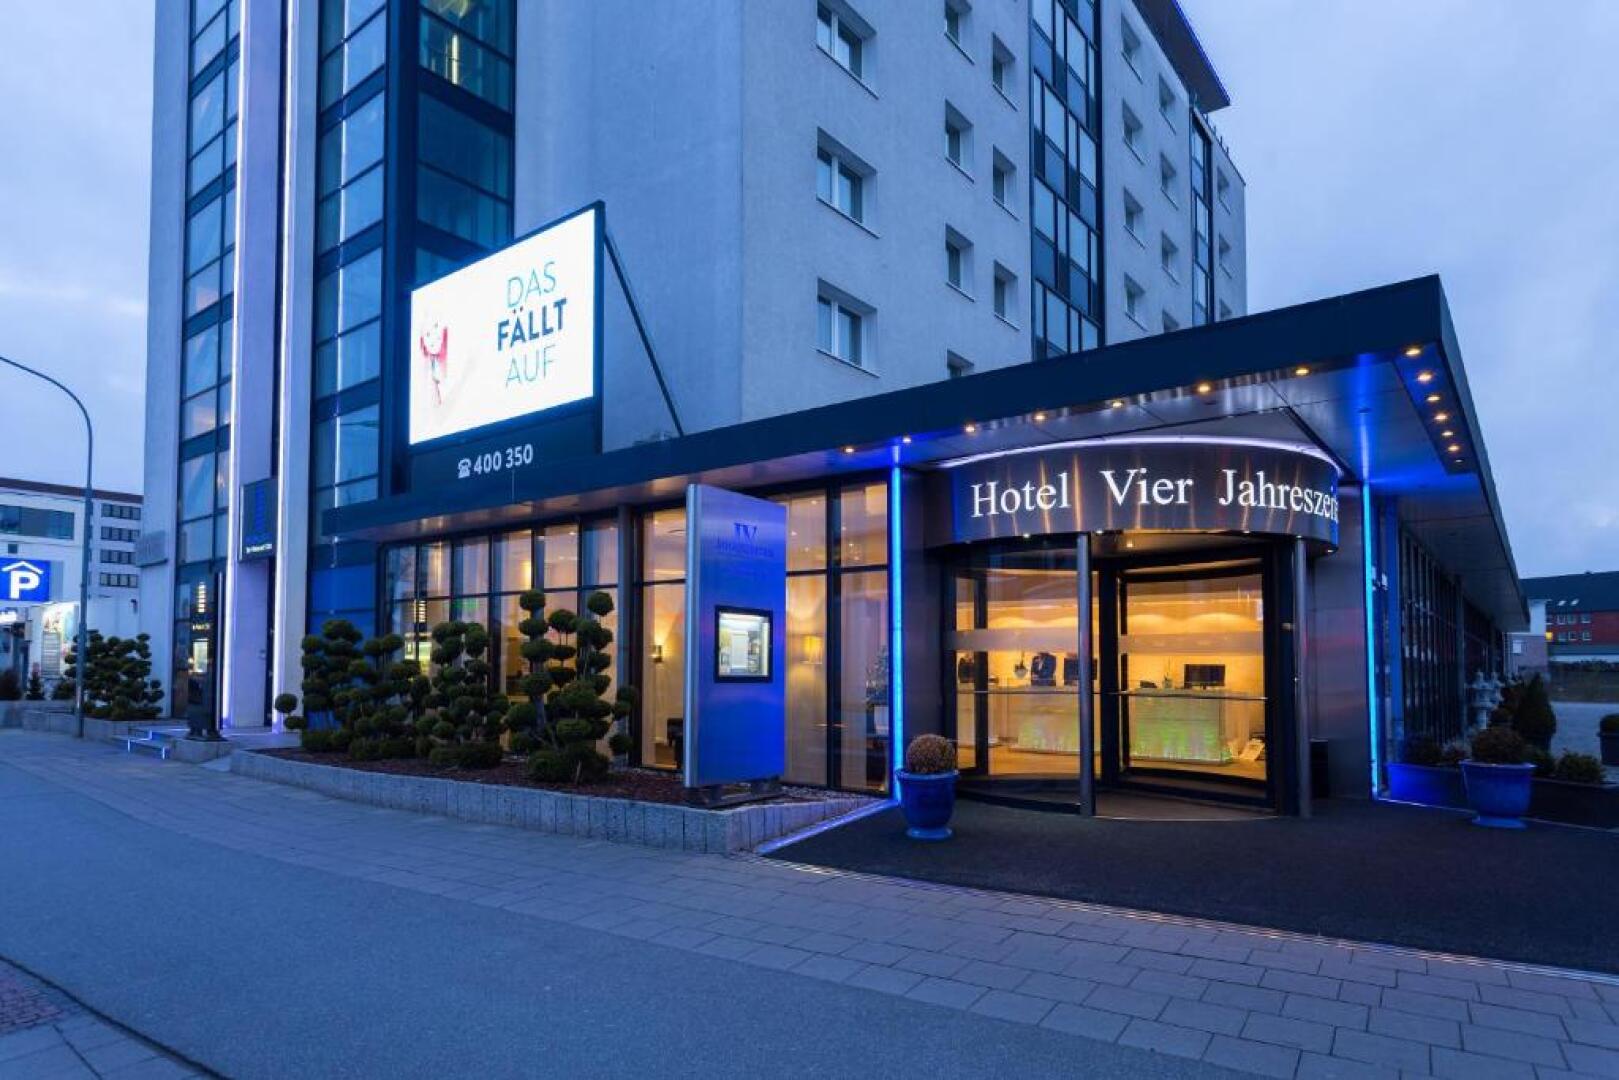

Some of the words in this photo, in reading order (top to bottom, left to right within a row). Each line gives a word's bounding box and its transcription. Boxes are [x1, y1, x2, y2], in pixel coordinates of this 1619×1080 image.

[507, 262, 557, 308] DAS
[498, 298, 568, 352] FÄLLT
[505, 345, 556, 389] AUF
[474, 454, 502, 475] 400
[505, 443, 534, 469] 350
[970, 472, 1073, 517] Hotel
[1100, 468, 1194, 505] Vier
[10, 570, 40, 598] P
